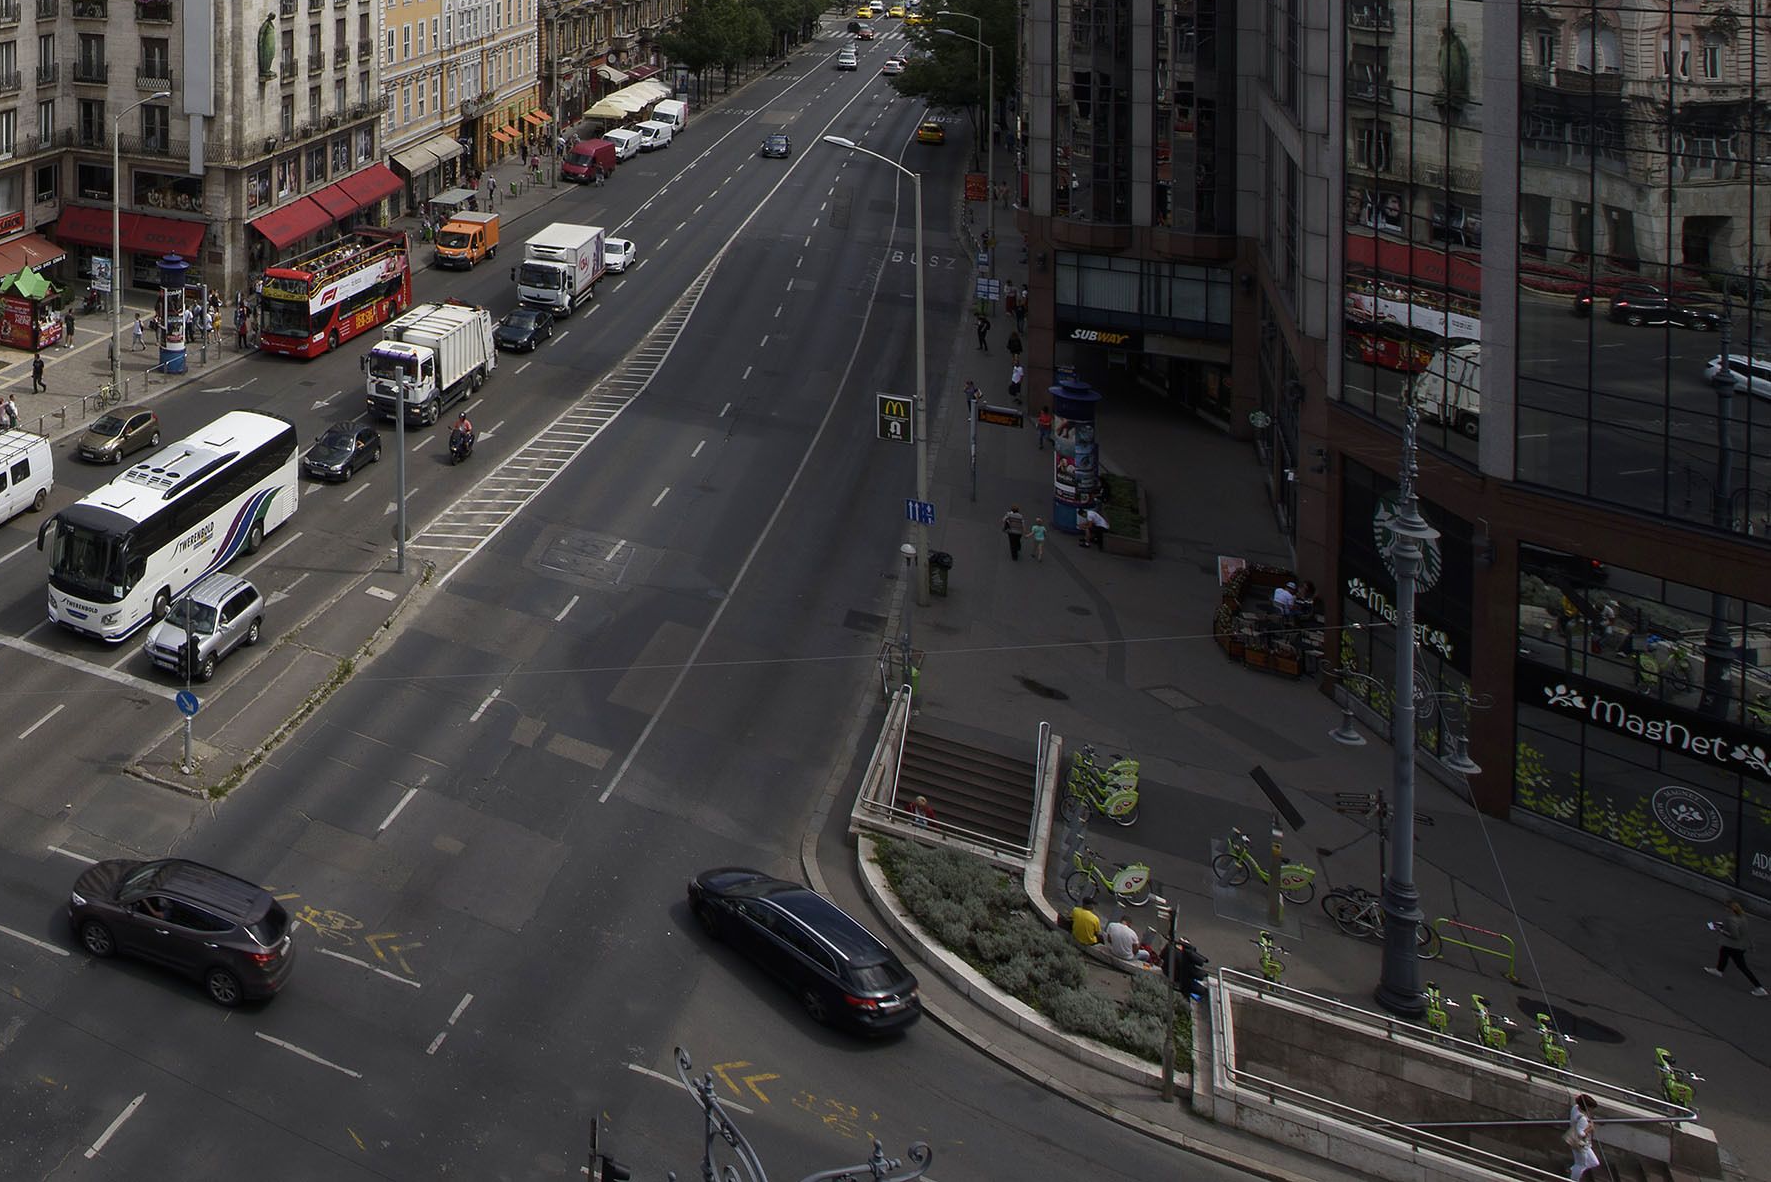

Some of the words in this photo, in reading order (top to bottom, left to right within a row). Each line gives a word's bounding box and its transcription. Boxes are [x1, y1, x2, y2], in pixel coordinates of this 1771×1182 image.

[1070, 329, 1129, 345] SUBWAY
[177, 521, 215, 554] TWERENBOLD
[64, 598, 99, 614] TWERENBOLD
